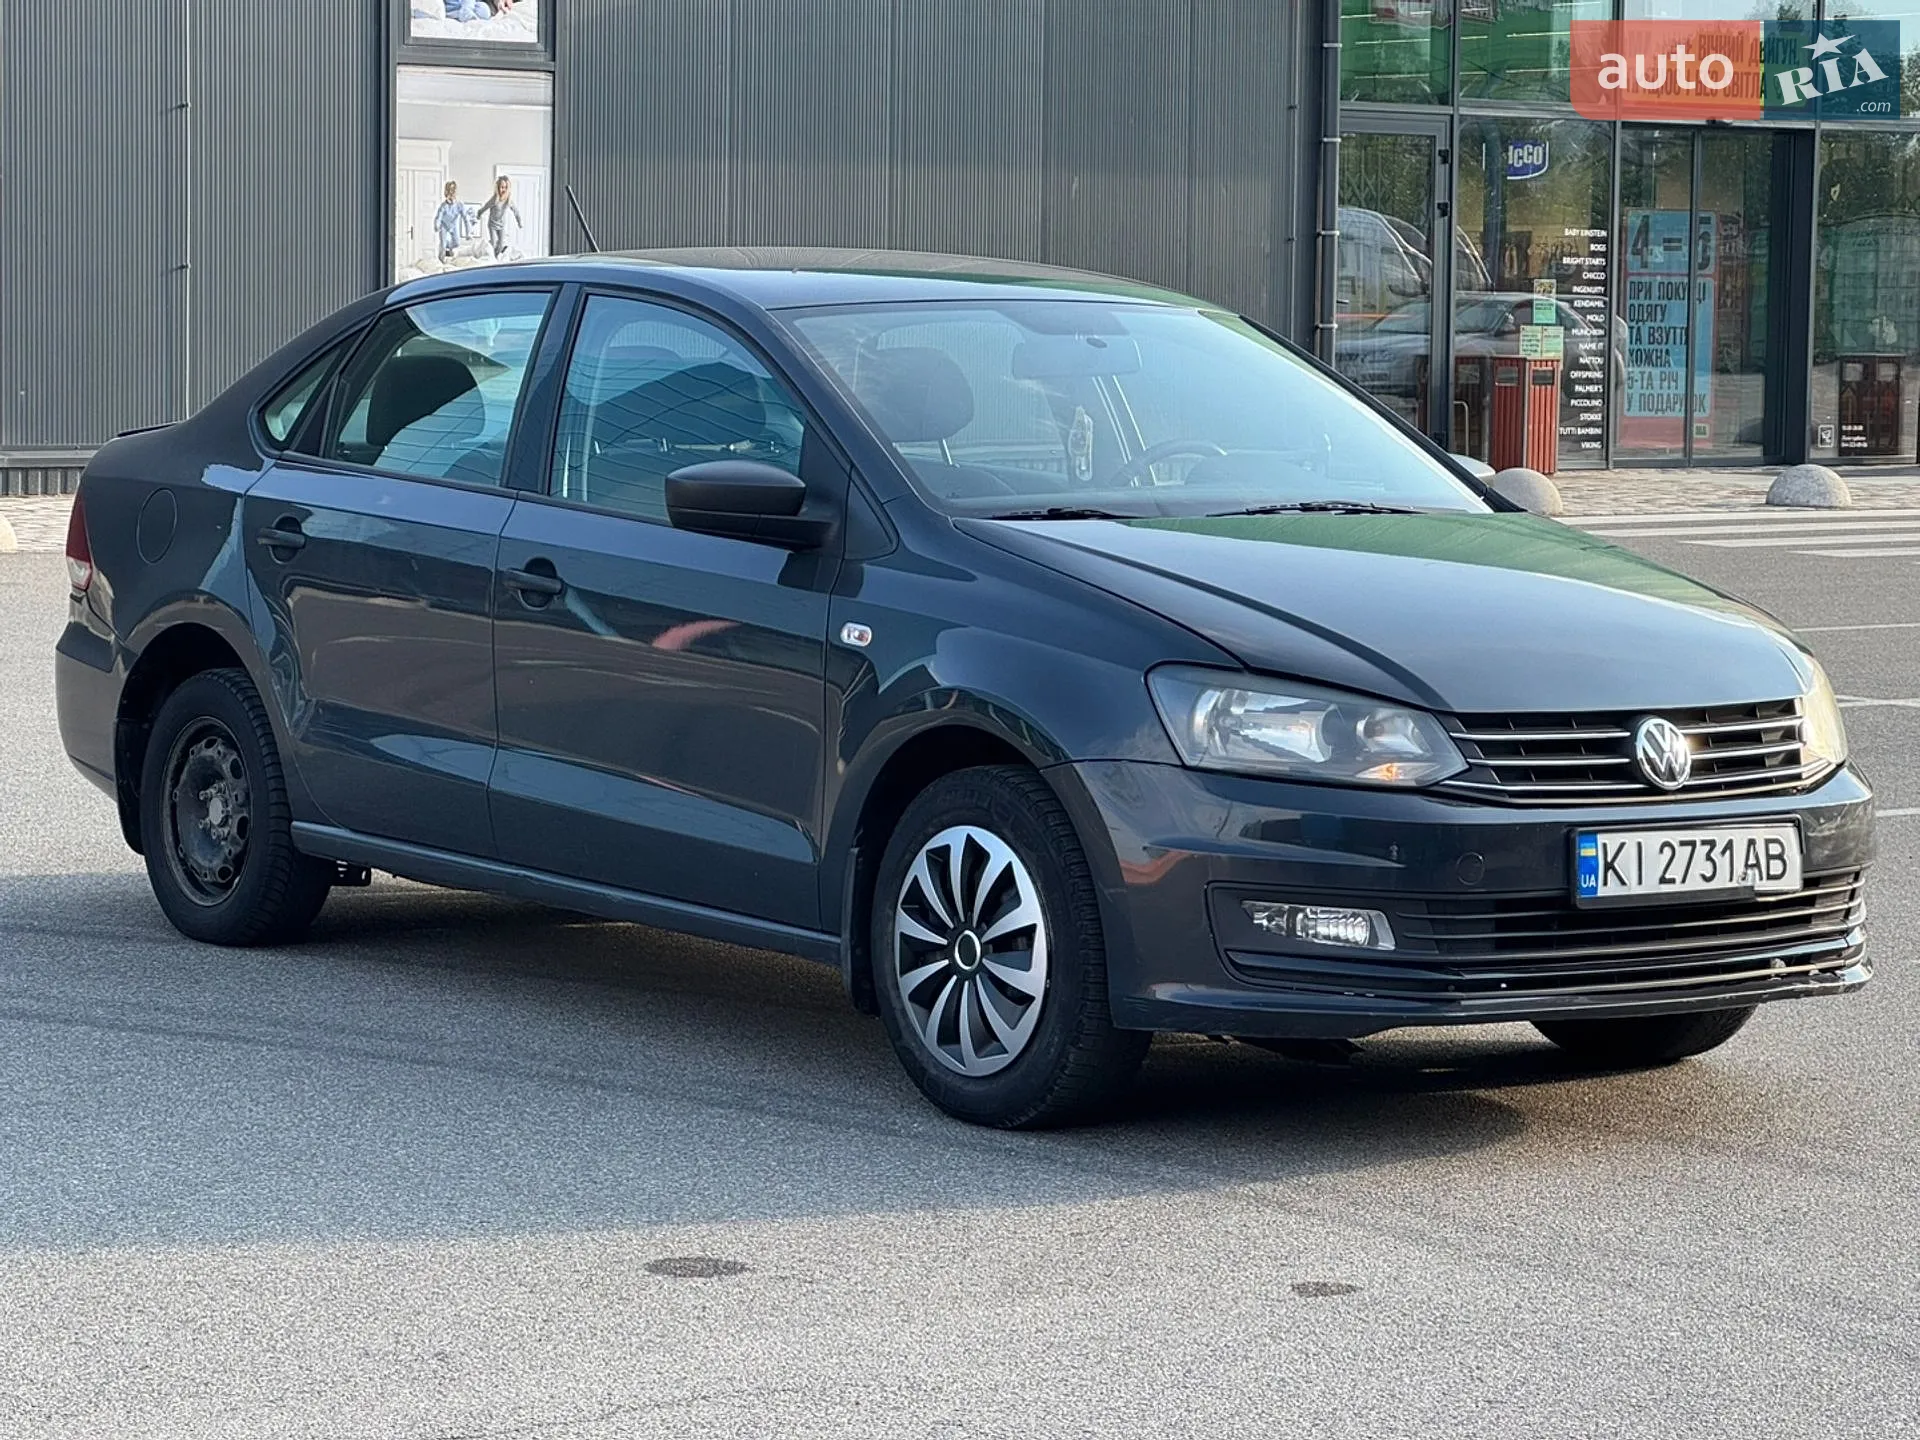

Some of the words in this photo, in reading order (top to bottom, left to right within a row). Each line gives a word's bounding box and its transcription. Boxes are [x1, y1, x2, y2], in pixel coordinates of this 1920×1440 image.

[1564, 228, 1580, 236] BABY
[1580, 229, 1607, 237] EINSTEIN
[1562, 256, 1585, 265] BRIGHT
[1585, 257, 1606, 266] STARTS
[1582, 272, 1606, 280] CHICCO
[1572, 286, 1605, 294] INGENUITY
[1629, 281, 1652, 301] ПРИ
[1658, 281, 1706, 304] ПОКУЦІ
[1586, 314, 1605, 322] MOLO
[1629, 304, 1667, 325] ОДЯГУ
[1628, 326, 1645, 345] ТА
[1570, 370, 1603, 379] OFFSPRING
[1659, 371, 1679, 390] РІЧ
[1638, 393, 1706, 414] ПОДАРУОК
[1601, 840, 1644, 888] KI
[1580, 873, 1598, 888] UA
